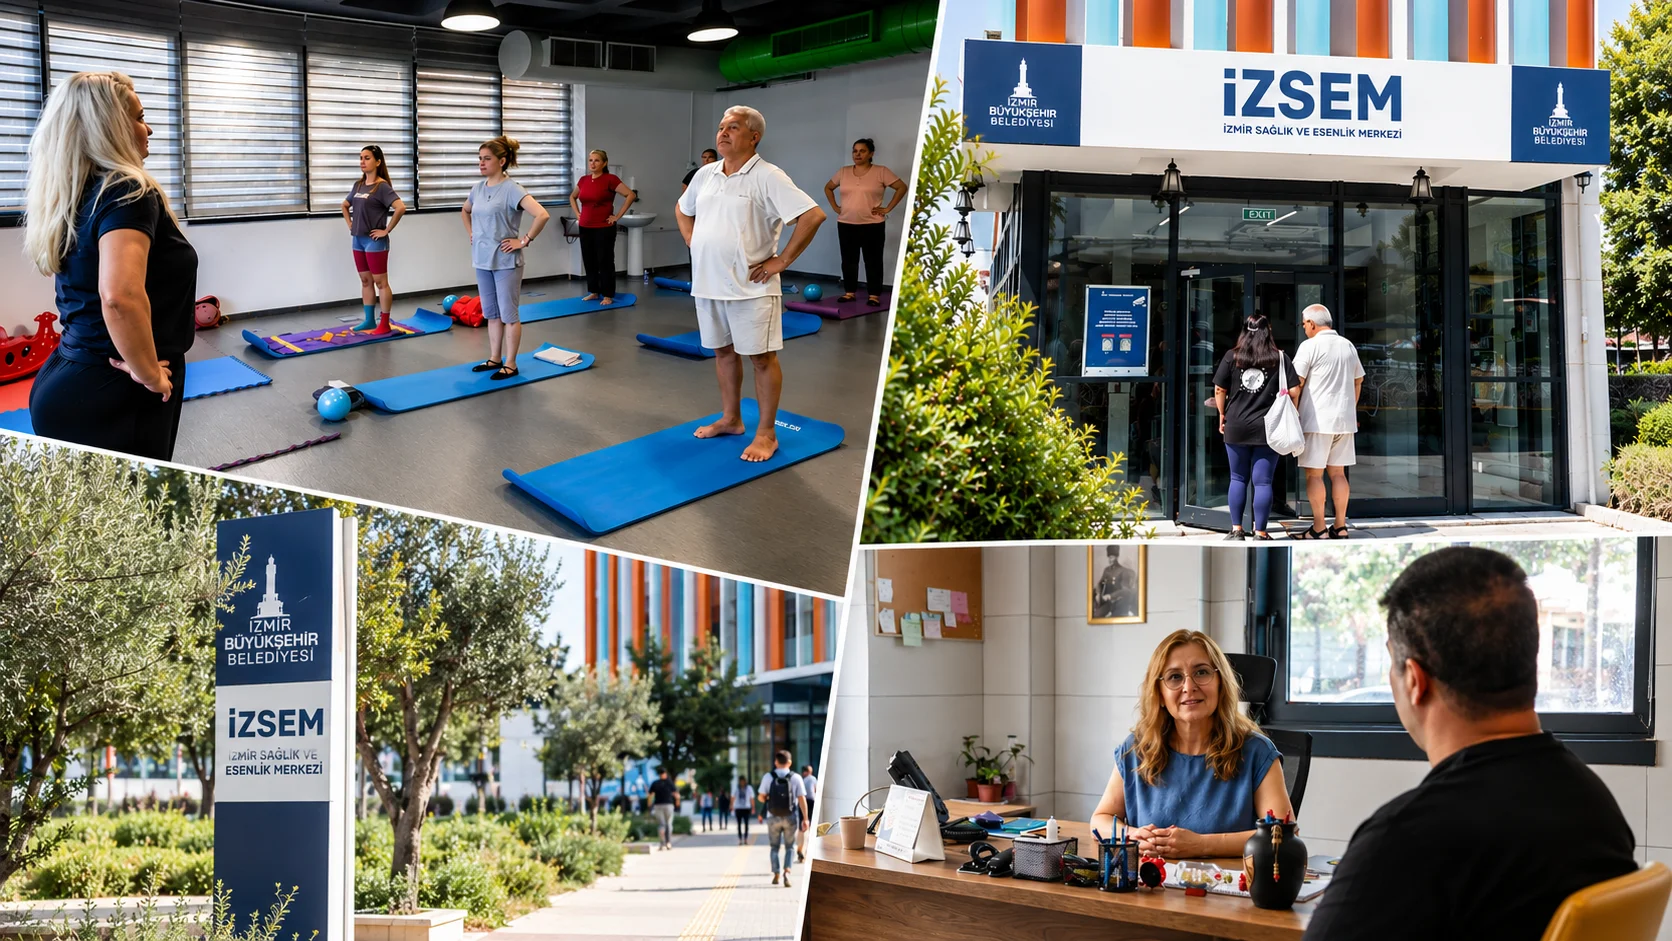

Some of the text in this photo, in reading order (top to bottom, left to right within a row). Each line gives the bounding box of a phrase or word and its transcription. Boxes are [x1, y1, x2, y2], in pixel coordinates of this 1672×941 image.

[1223, 123, 1253, 135] İZMİR
[1297, 126, 1310, 137] VE
[1312, 126, 1356, 138] ESENLİK
[1358, 128, 1403, 139] MERKEZİ
[1249, 210, 1271, 219] EXIT
[303, 748, 318, 760] VE
[225, 761, 323, 776] ESENLİK MERKEZİ
